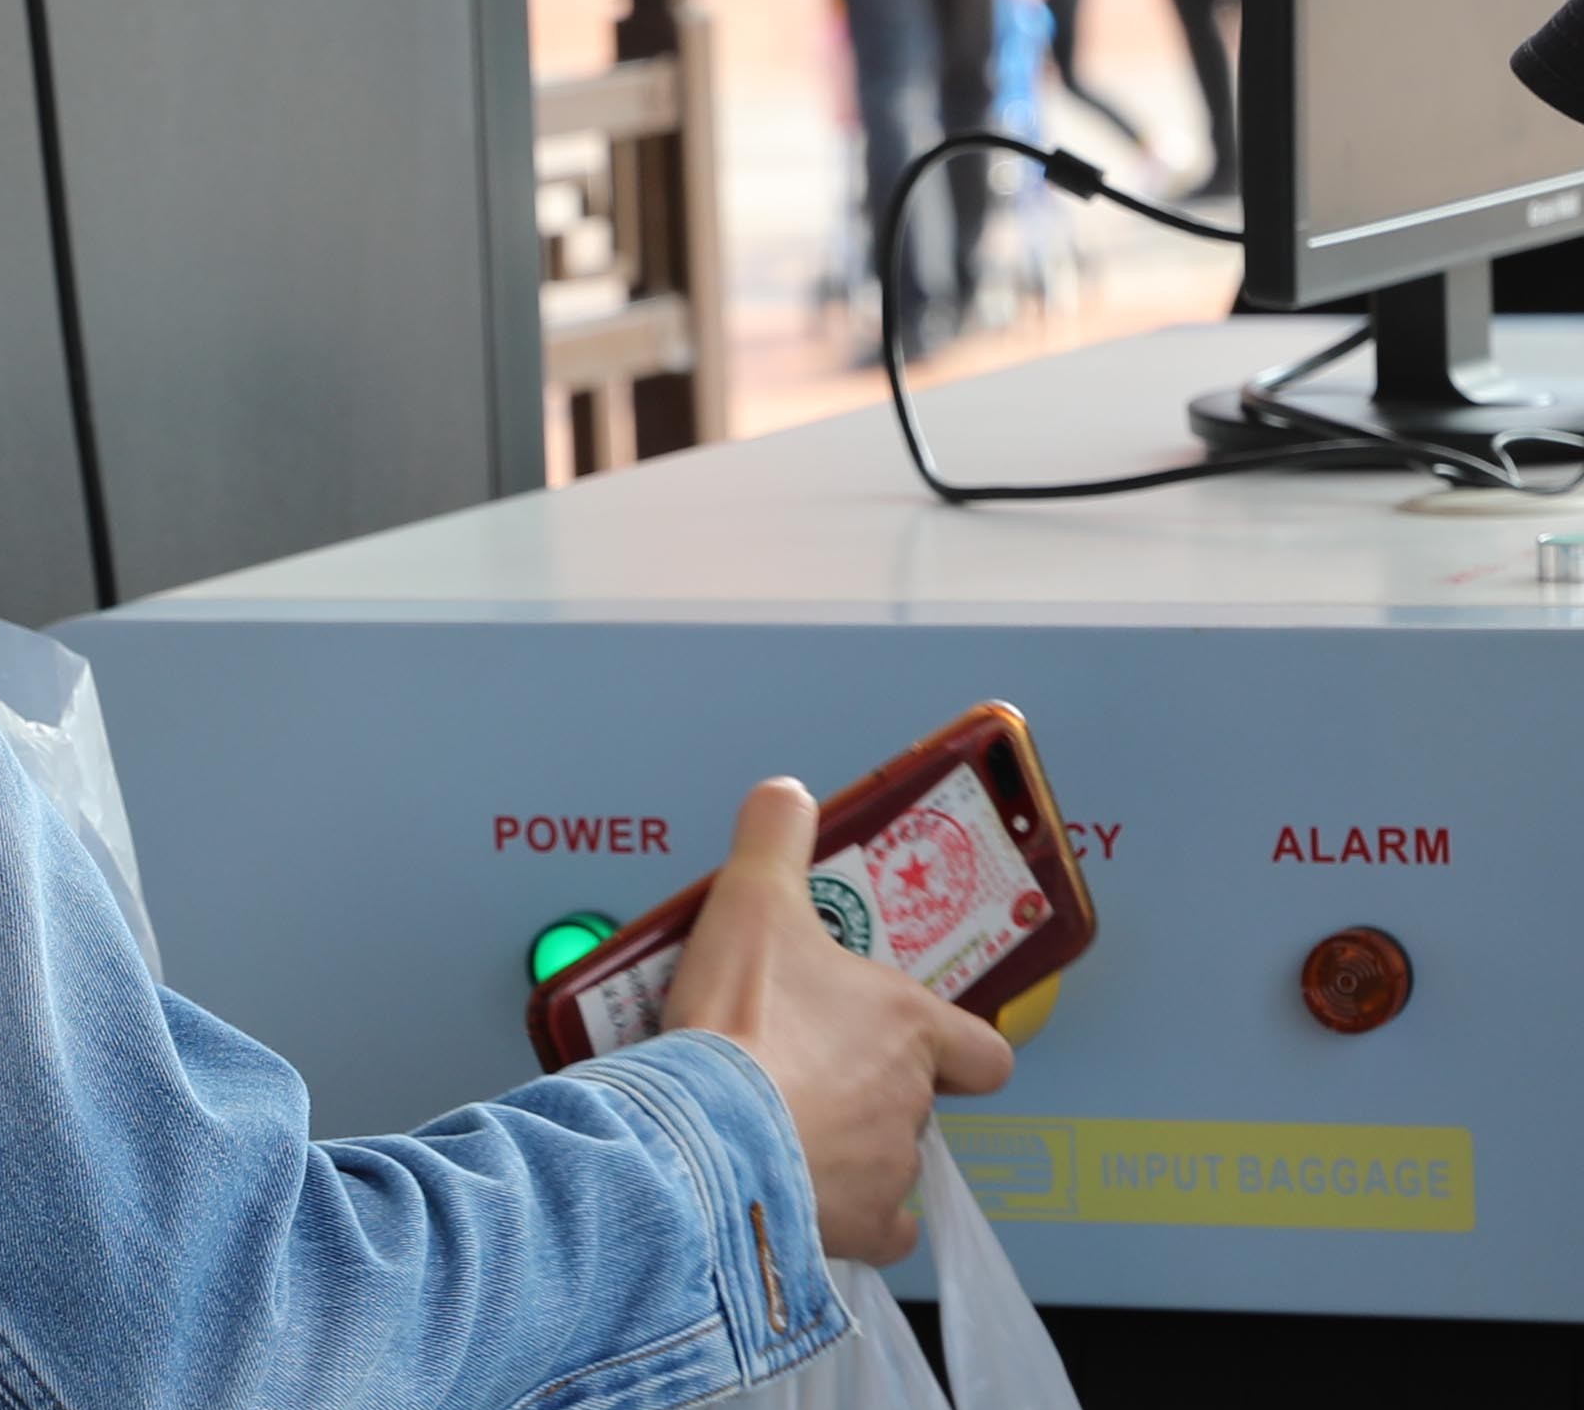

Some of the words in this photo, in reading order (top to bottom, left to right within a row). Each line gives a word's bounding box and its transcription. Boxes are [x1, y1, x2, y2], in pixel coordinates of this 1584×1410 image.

[494, 816, 670, 854] POWER
[1272, 826, 1452, 865] ALARM
[1100, 1152, 1222, 1191] INPUT
[1236, 1154, 1454, 1199] BAGGAGE
